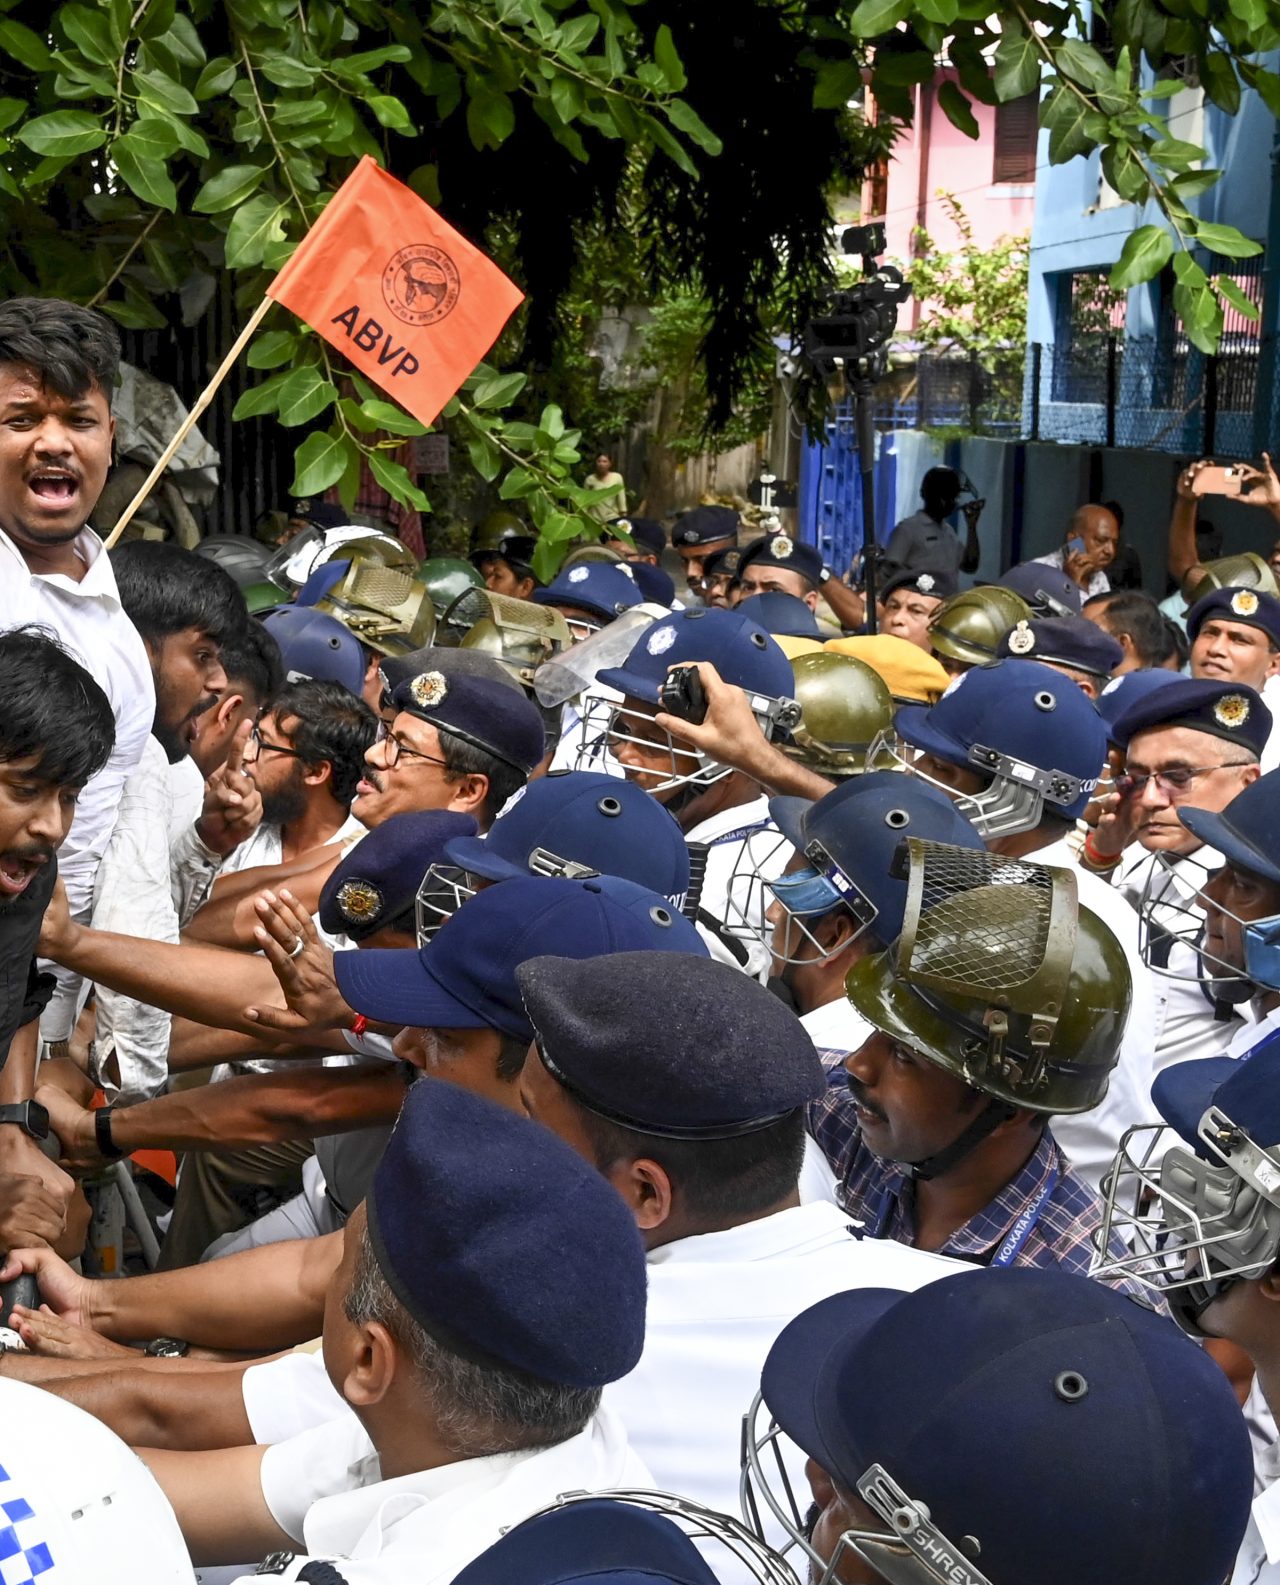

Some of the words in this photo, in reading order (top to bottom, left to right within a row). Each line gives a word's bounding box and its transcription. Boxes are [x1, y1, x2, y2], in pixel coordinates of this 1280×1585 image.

[331, 305, 419, 376] ABVP
[999, 1220, 1029, 1262] KOLKATA
[1023, 1186, 1047, 1220] POLICE
